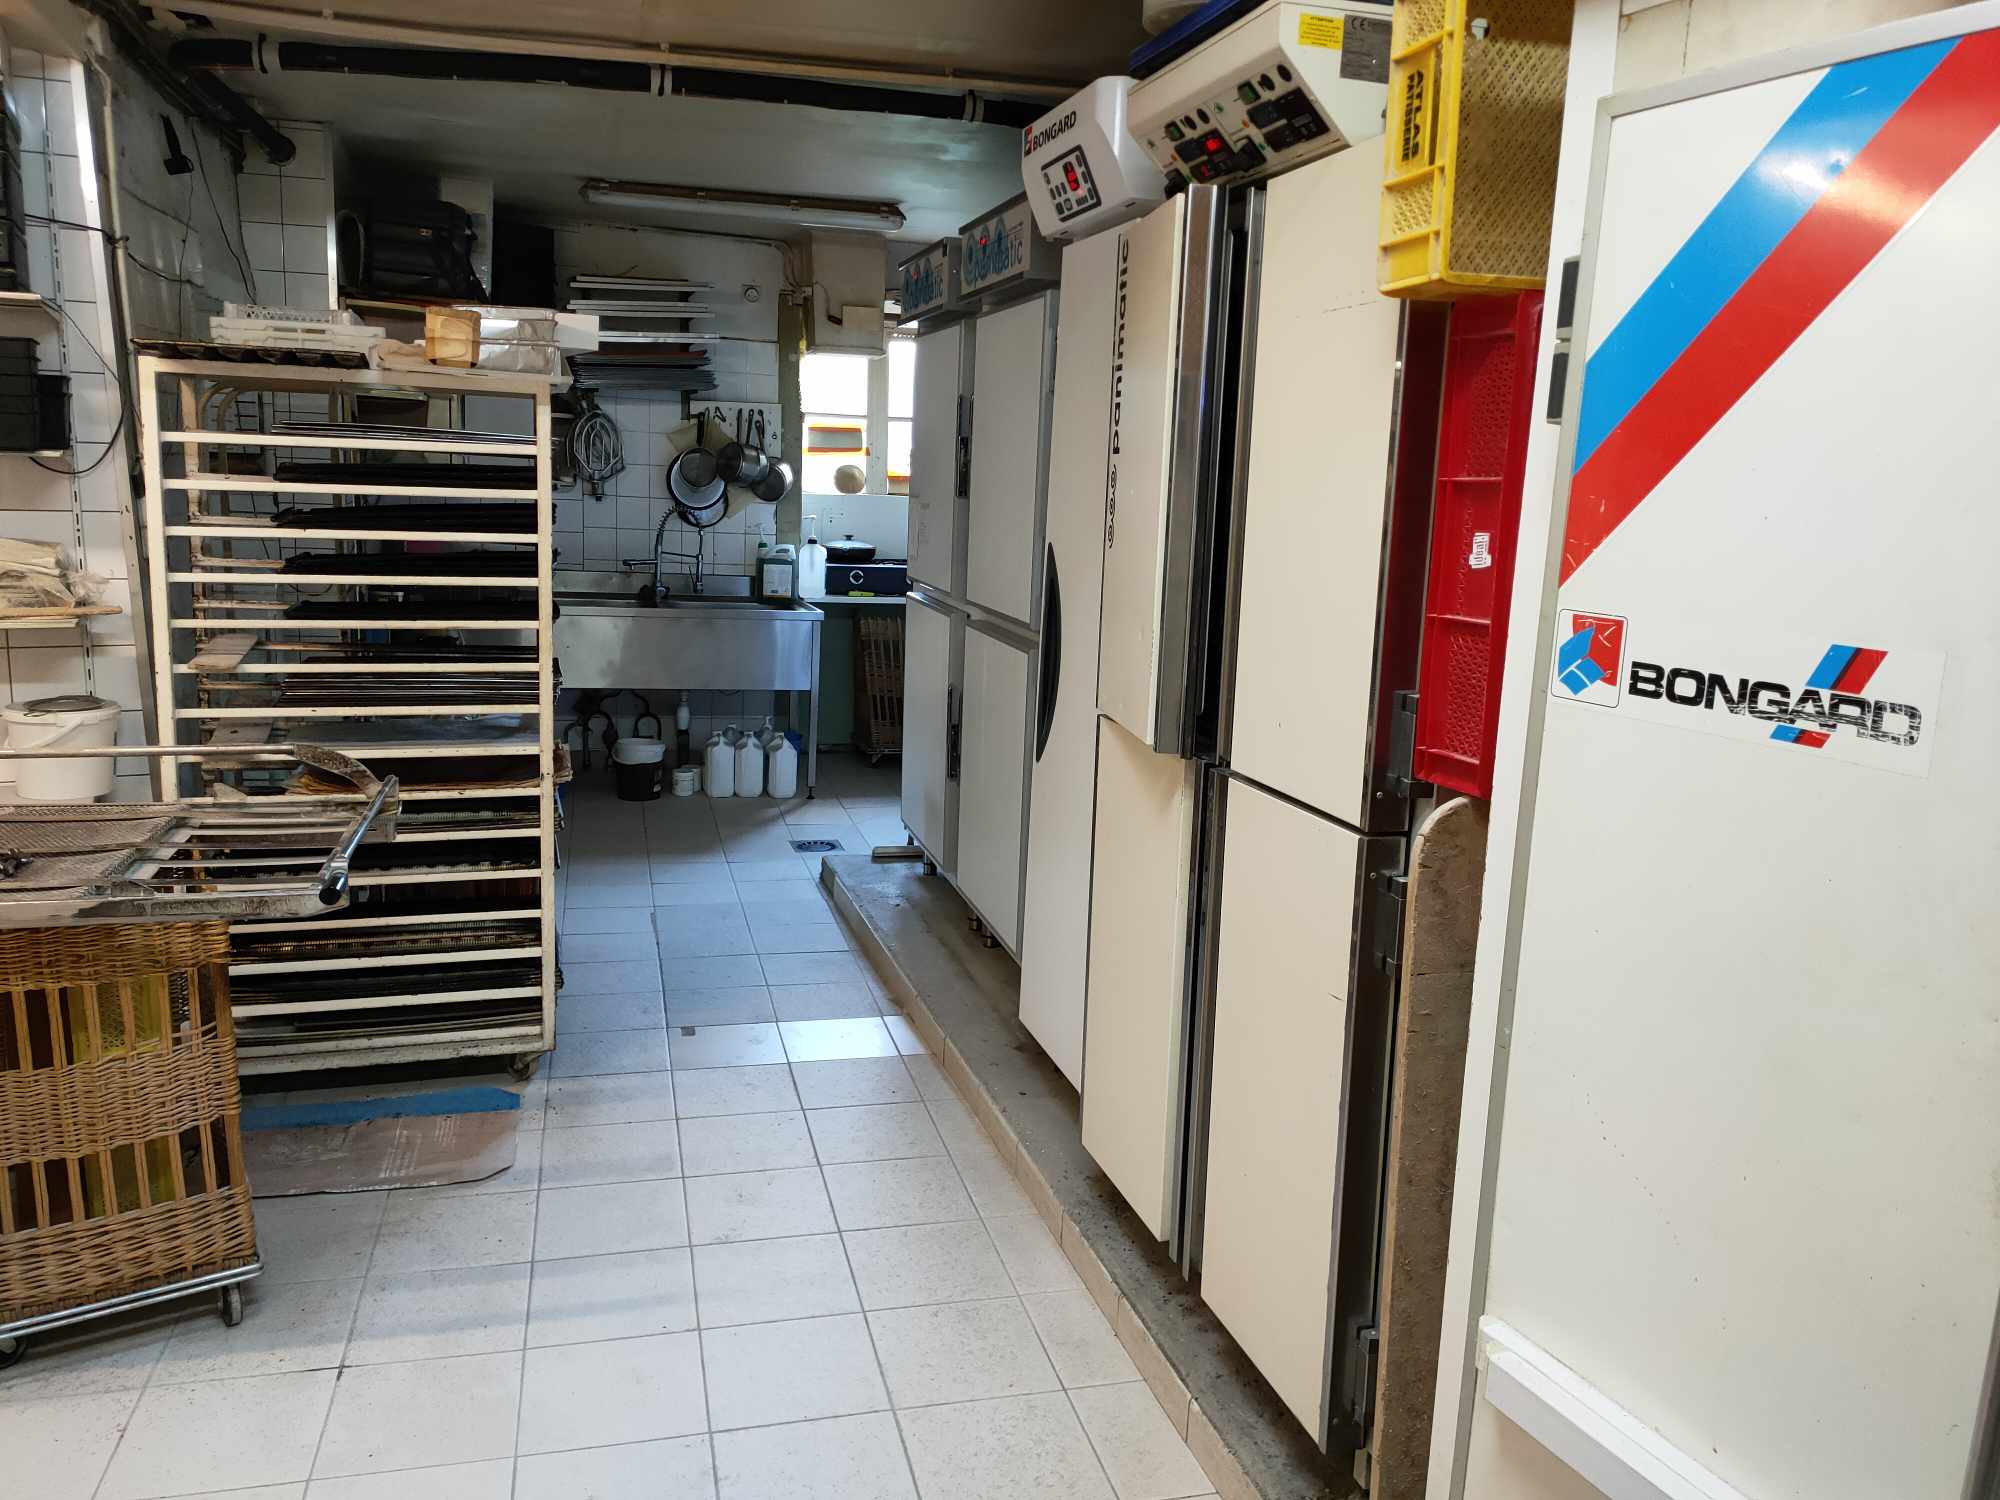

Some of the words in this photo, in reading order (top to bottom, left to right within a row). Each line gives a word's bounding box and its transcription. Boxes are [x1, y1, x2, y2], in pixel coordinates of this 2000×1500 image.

[1032, 111, 1077, 152] BONGARD
[1412, 70, 1424, 158] ATLAS
[1112, 238, 1130, 455] panimatic
[1628, 661, 1922, 747] BONGARD
